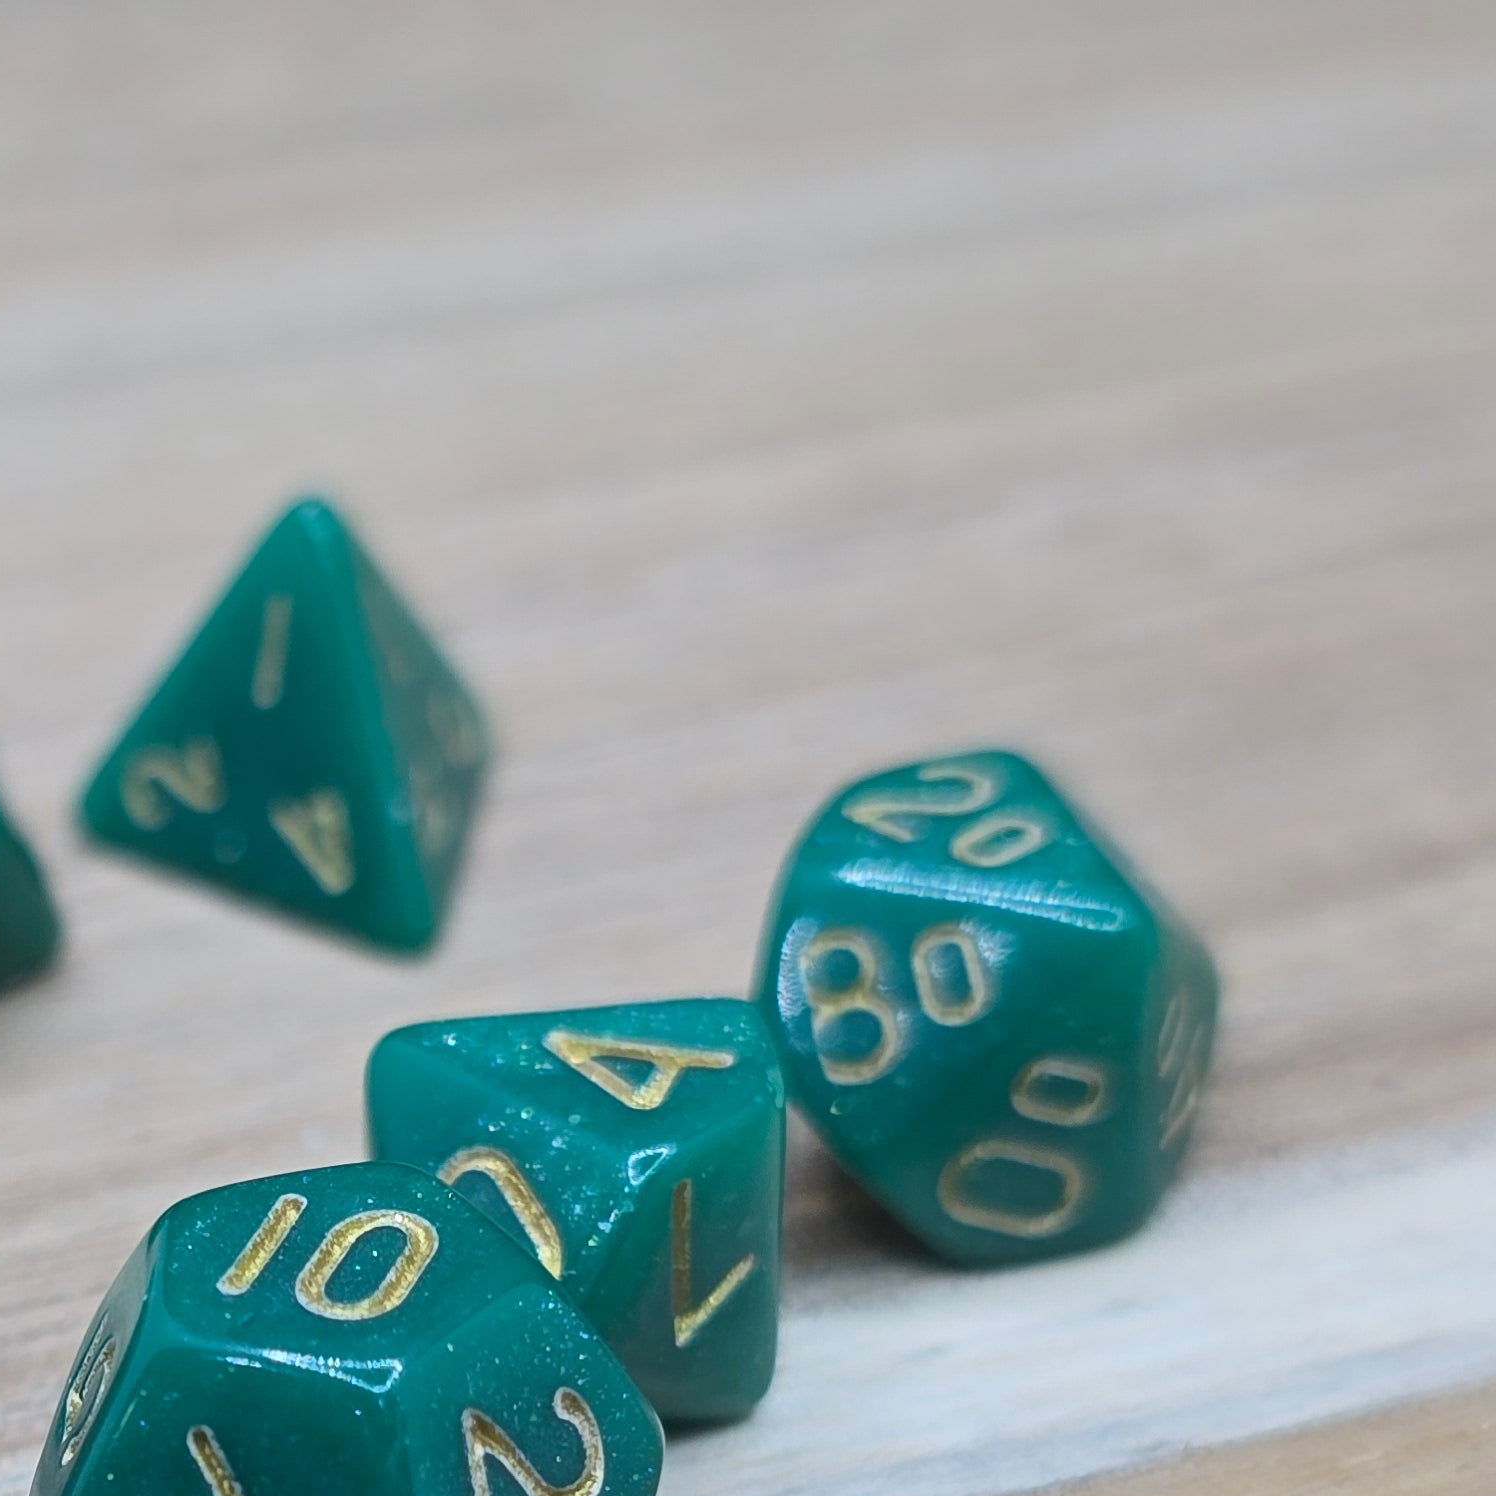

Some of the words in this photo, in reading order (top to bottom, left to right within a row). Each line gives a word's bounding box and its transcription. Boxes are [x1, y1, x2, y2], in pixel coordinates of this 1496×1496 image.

[251, 595, 293, 710] 1
[122, 735, 228, 831] 2
[842, 765, 1052, 868] 20
[270, 788, 356, 895] 4
[800, 923, 986, 1086] 80
[542, 1028, 736, 1111] 4
[937, 1056, 1106, 1239] 00
[216, 1193, 440, 1321] 10
